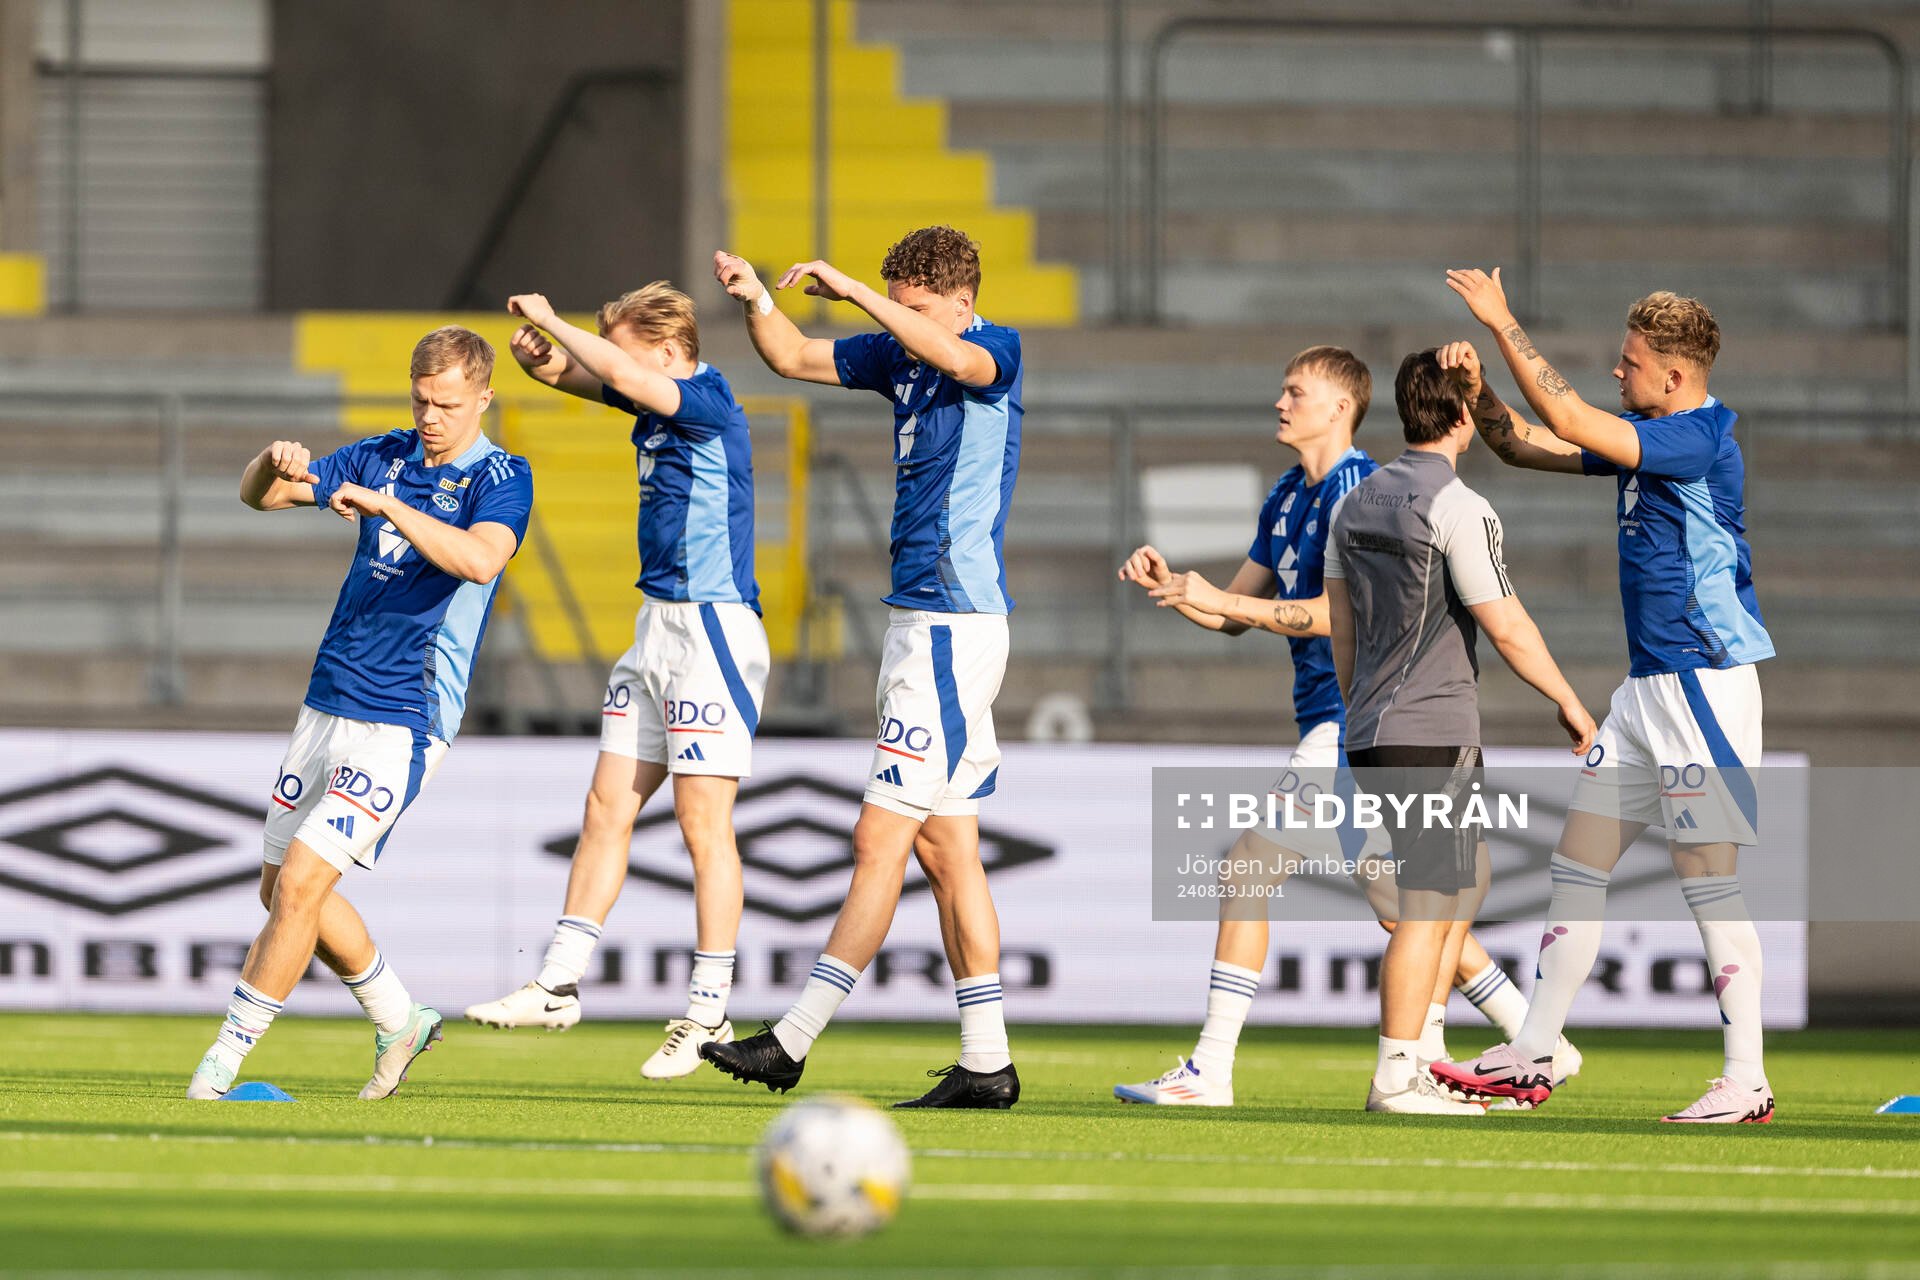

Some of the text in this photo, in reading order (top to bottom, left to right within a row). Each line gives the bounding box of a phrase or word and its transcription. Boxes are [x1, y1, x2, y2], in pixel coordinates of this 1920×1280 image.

[385, 457, 406, 480] 19
[1359, 488, 1404, 508] Vikenco
[335, 765, 394, 812] BDO
